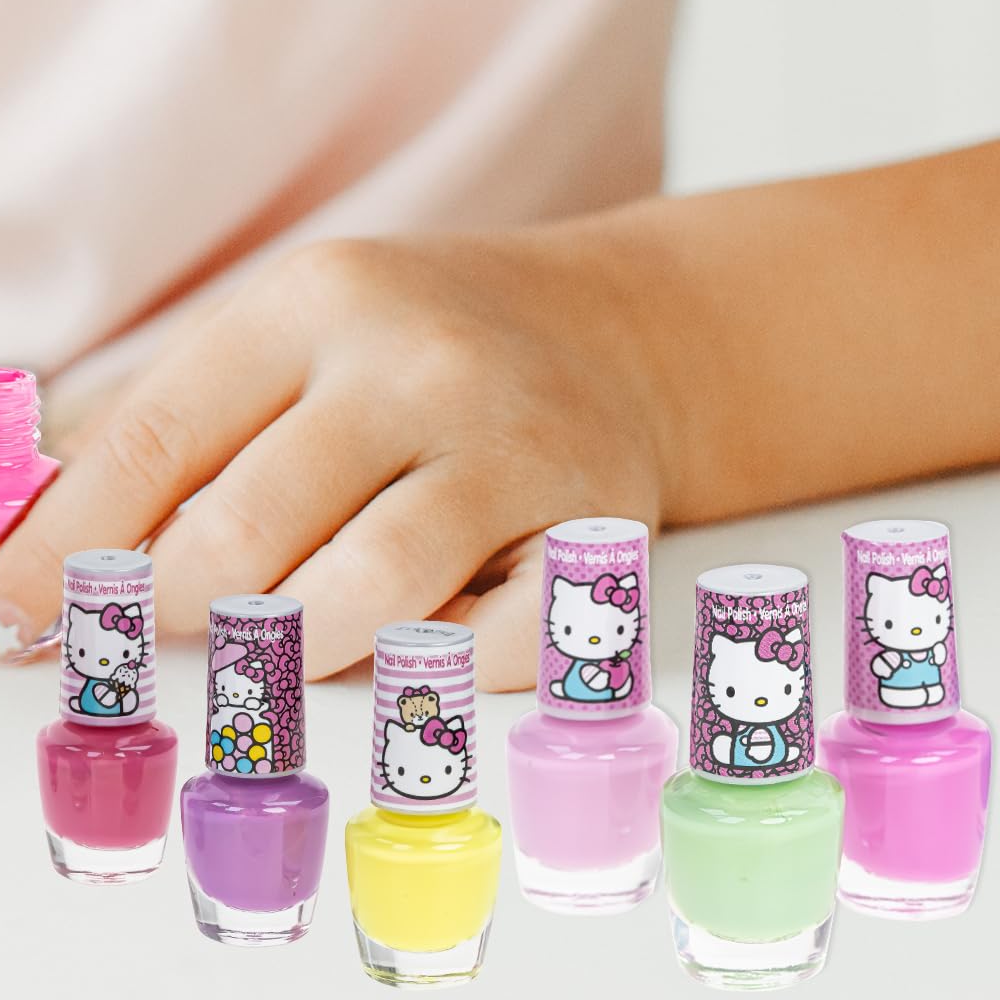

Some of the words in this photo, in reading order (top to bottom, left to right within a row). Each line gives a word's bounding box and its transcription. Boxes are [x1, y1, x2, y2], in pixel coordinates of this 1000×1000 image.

[557, 548, 577, 564] Polish
[584, 551, 608, 565] Vernis
[617, 549, 638, 566] Ongles
[857, 549, 870, 563] Nail
[872, 551, 895, 566] Polish
[901, 552, 925, 566] Vernis
[76, 581, 92, 593] Polish
[98, 584, 118, 595] Vernis
[127, 581, 145, 596] Ongles
[712, 604, 726, 619] Nail
[727, 606, 752, 620] Polish
[760, 606, 782, 620] Vernis
[232, 627, 252, 640] Vernis
[261, 628, 284, 643] Ongles
[384, 653, 396, 665] Nail
[397, 655, 416, 668] Polish
[423, 655, 445, 668] Vernis
[453, 652, 470, 667] Ongles
